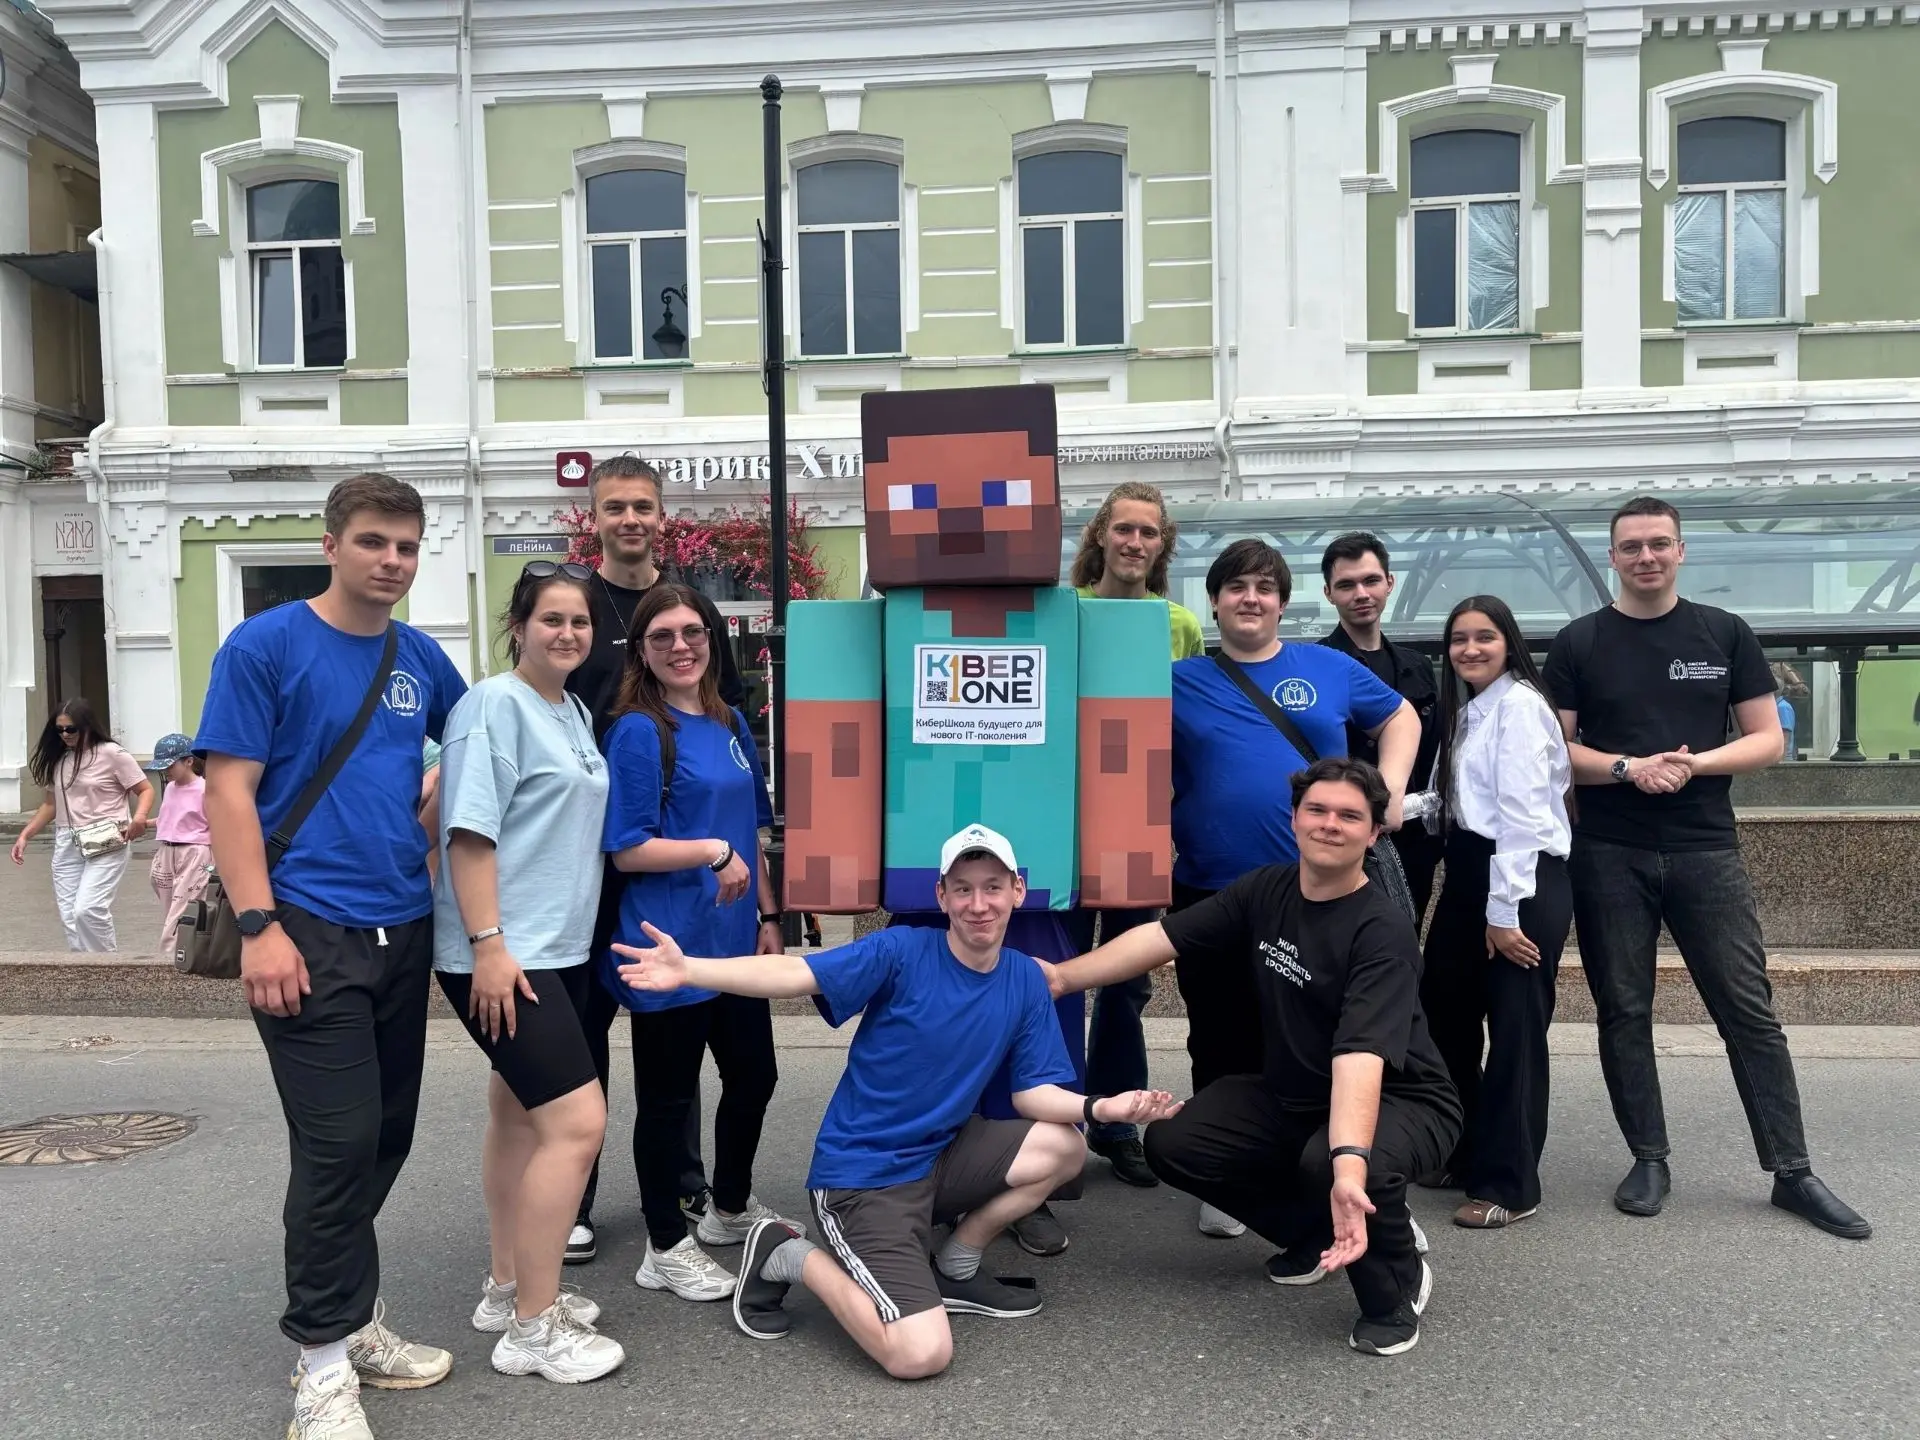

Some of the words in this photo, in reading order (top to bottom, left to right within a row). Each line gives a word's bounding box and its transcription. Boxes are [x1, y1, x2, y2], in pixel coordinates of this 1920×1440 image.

[1091, 442, 1213, 462] хинкальных
[509, 543, 553, 552] ЛЕНИНА
[961, 680, 1033, 704] ONE
[915, 718, 975, 729] КиберШкола
[978, 719, 1023, 730] будущего
[1025, 720, 1043, 729] для
[930, 731, 963, 740] нового
[965, 731, 1027, 740] IT-поколения
